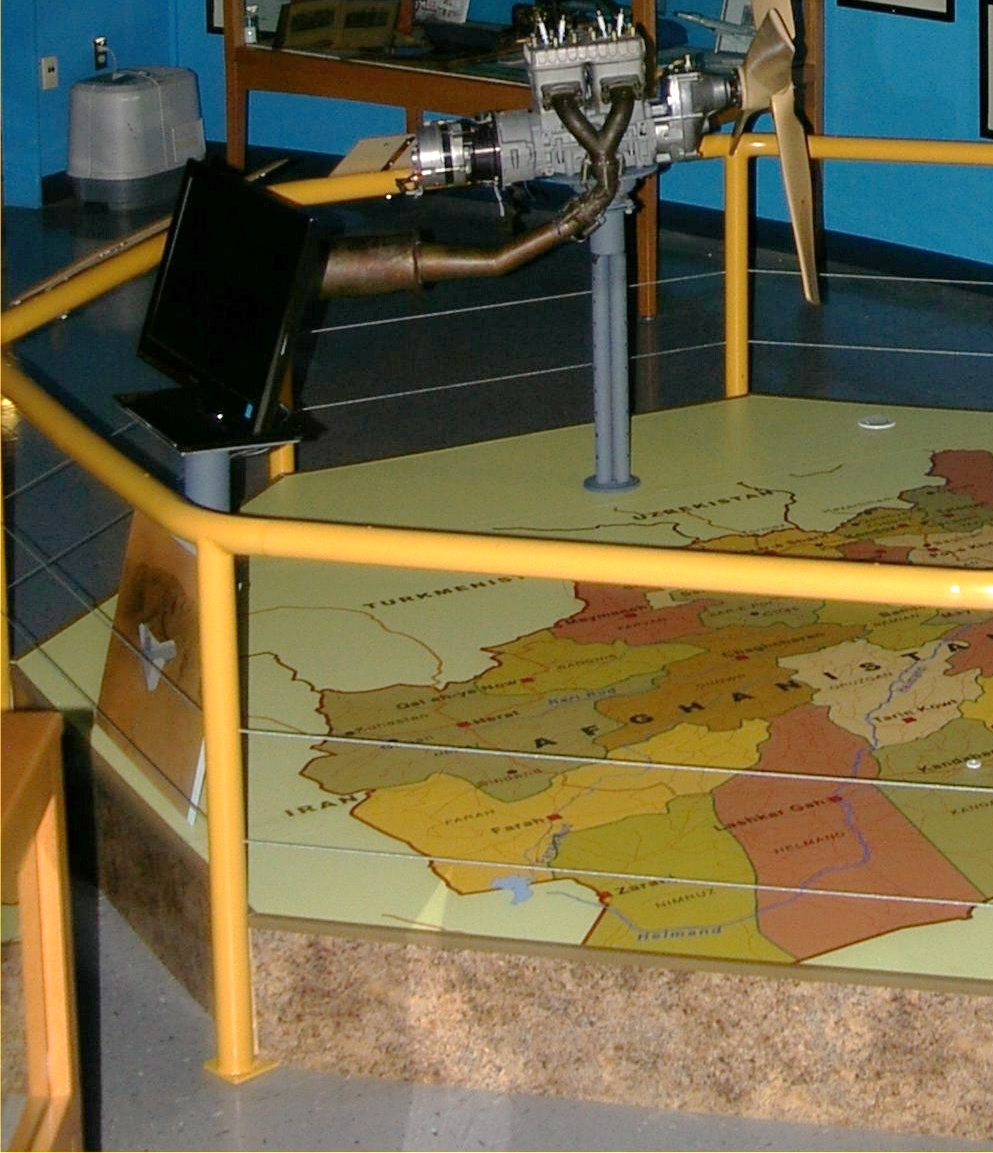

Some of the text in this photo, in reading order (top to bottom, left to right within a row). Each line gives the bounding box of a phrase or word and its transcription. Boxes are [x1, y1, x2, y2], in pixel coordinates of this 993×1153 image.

[362, 577, 526, 609] TURKMENIS
[285, 794, 359, 817] IRAN
[491, 816, 546, 834] Farah
